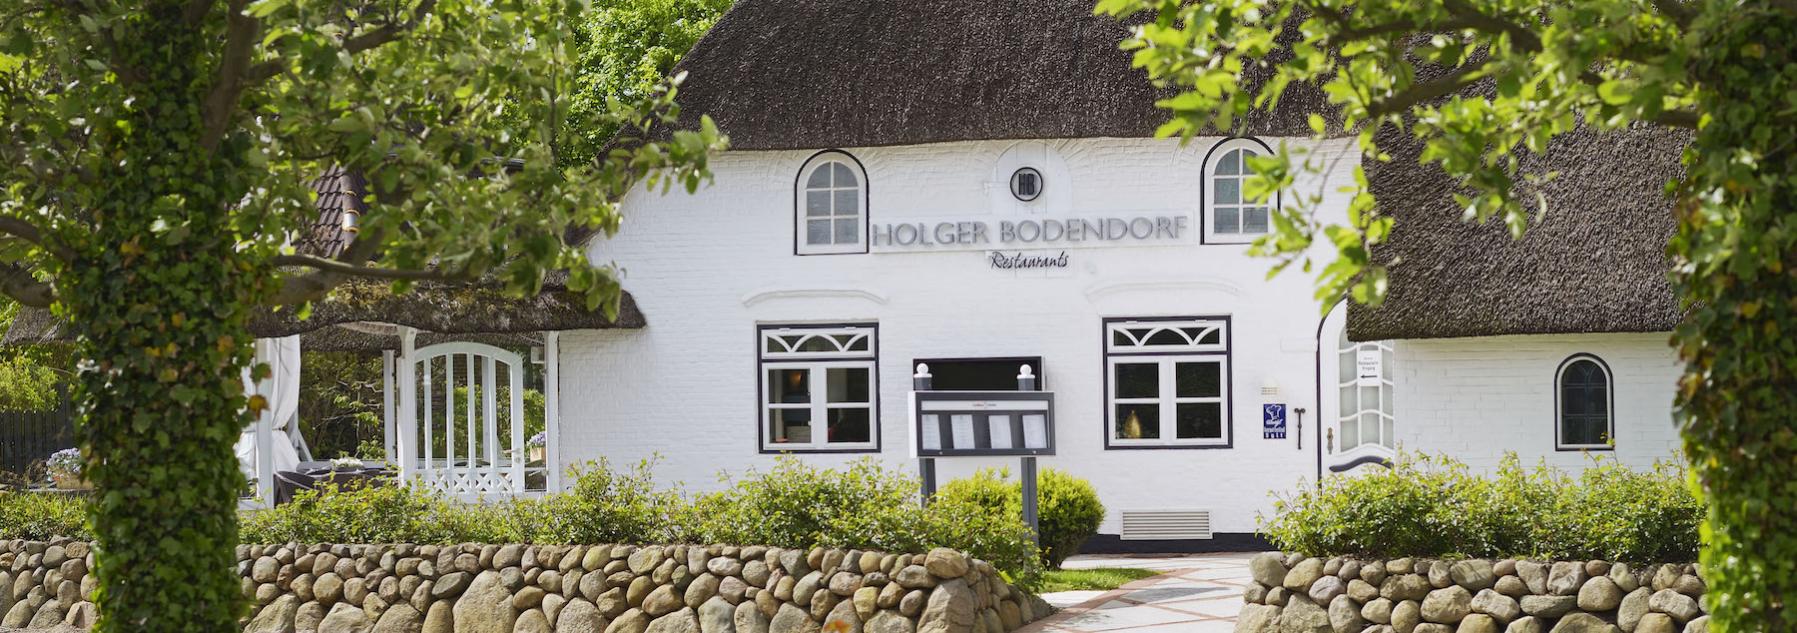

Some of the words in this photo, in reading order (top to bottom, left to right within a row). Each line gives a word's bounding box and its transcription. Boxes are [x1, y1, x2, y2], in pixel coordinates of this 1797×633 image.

[1018, 173, 1036, 196] HB
[872, 221, 990, 247] HOLGER
[1000, 215, 1188, 243] BODENDORF
[990, 250, 1070, 270] Restaurants
